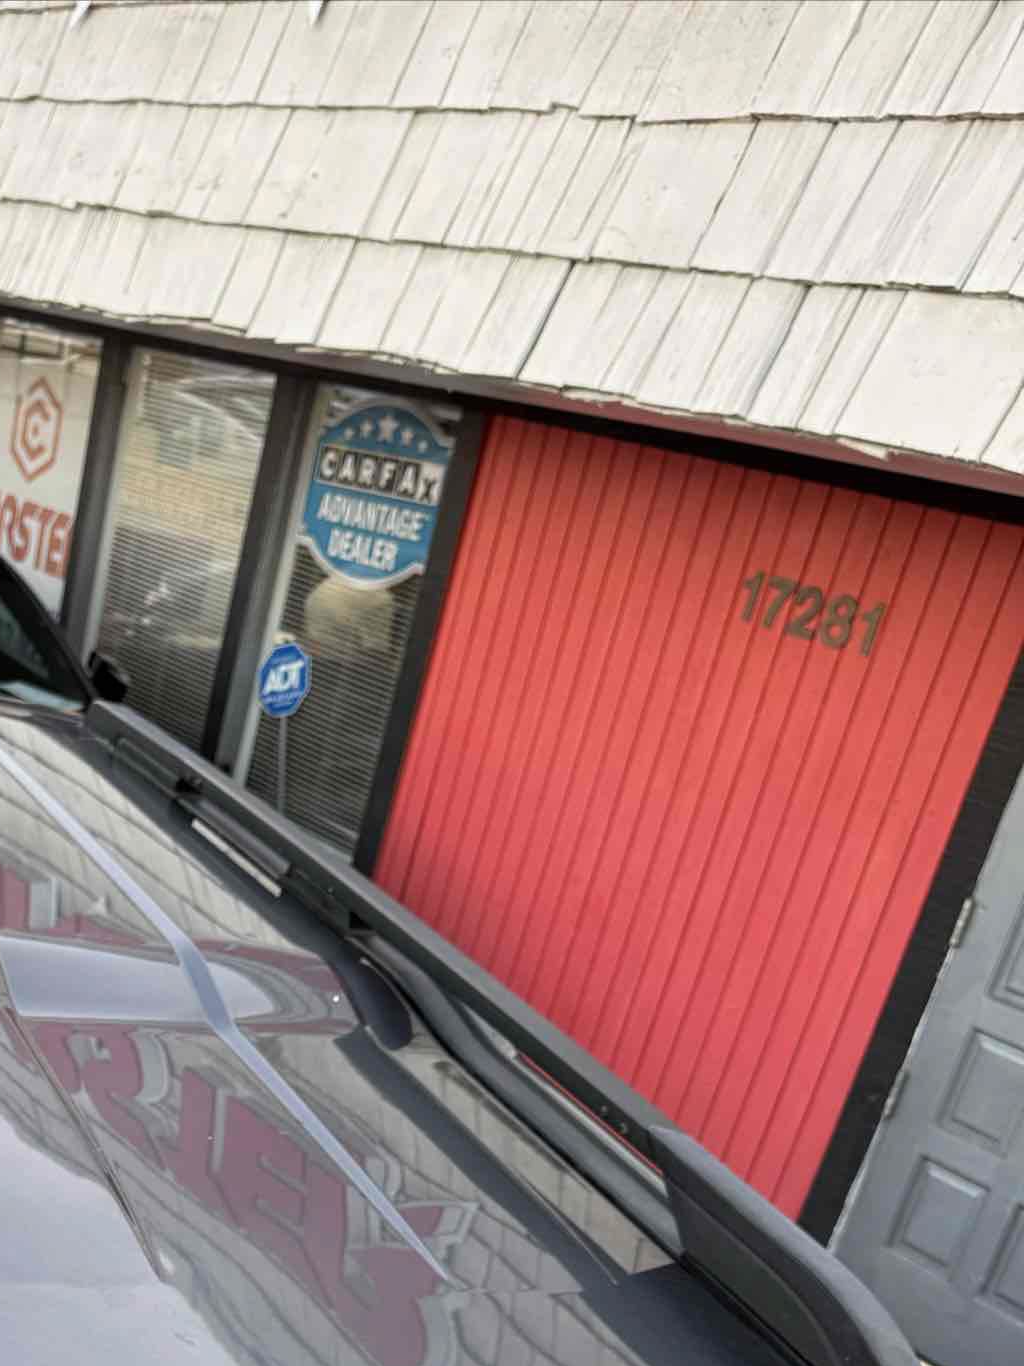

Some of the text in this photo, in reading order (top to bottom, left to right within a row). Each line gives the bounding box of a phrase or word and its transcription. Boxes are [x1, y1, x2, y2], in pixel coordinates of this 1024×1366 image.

[319, 450, 442, 504] CARFAX
[317, 491, 428, 541] ADVANTAGE
[328, 527, 399, 572] DEALER
[741, 569, 887, 657] 17281
[261, 660, 305, 695] ADT
